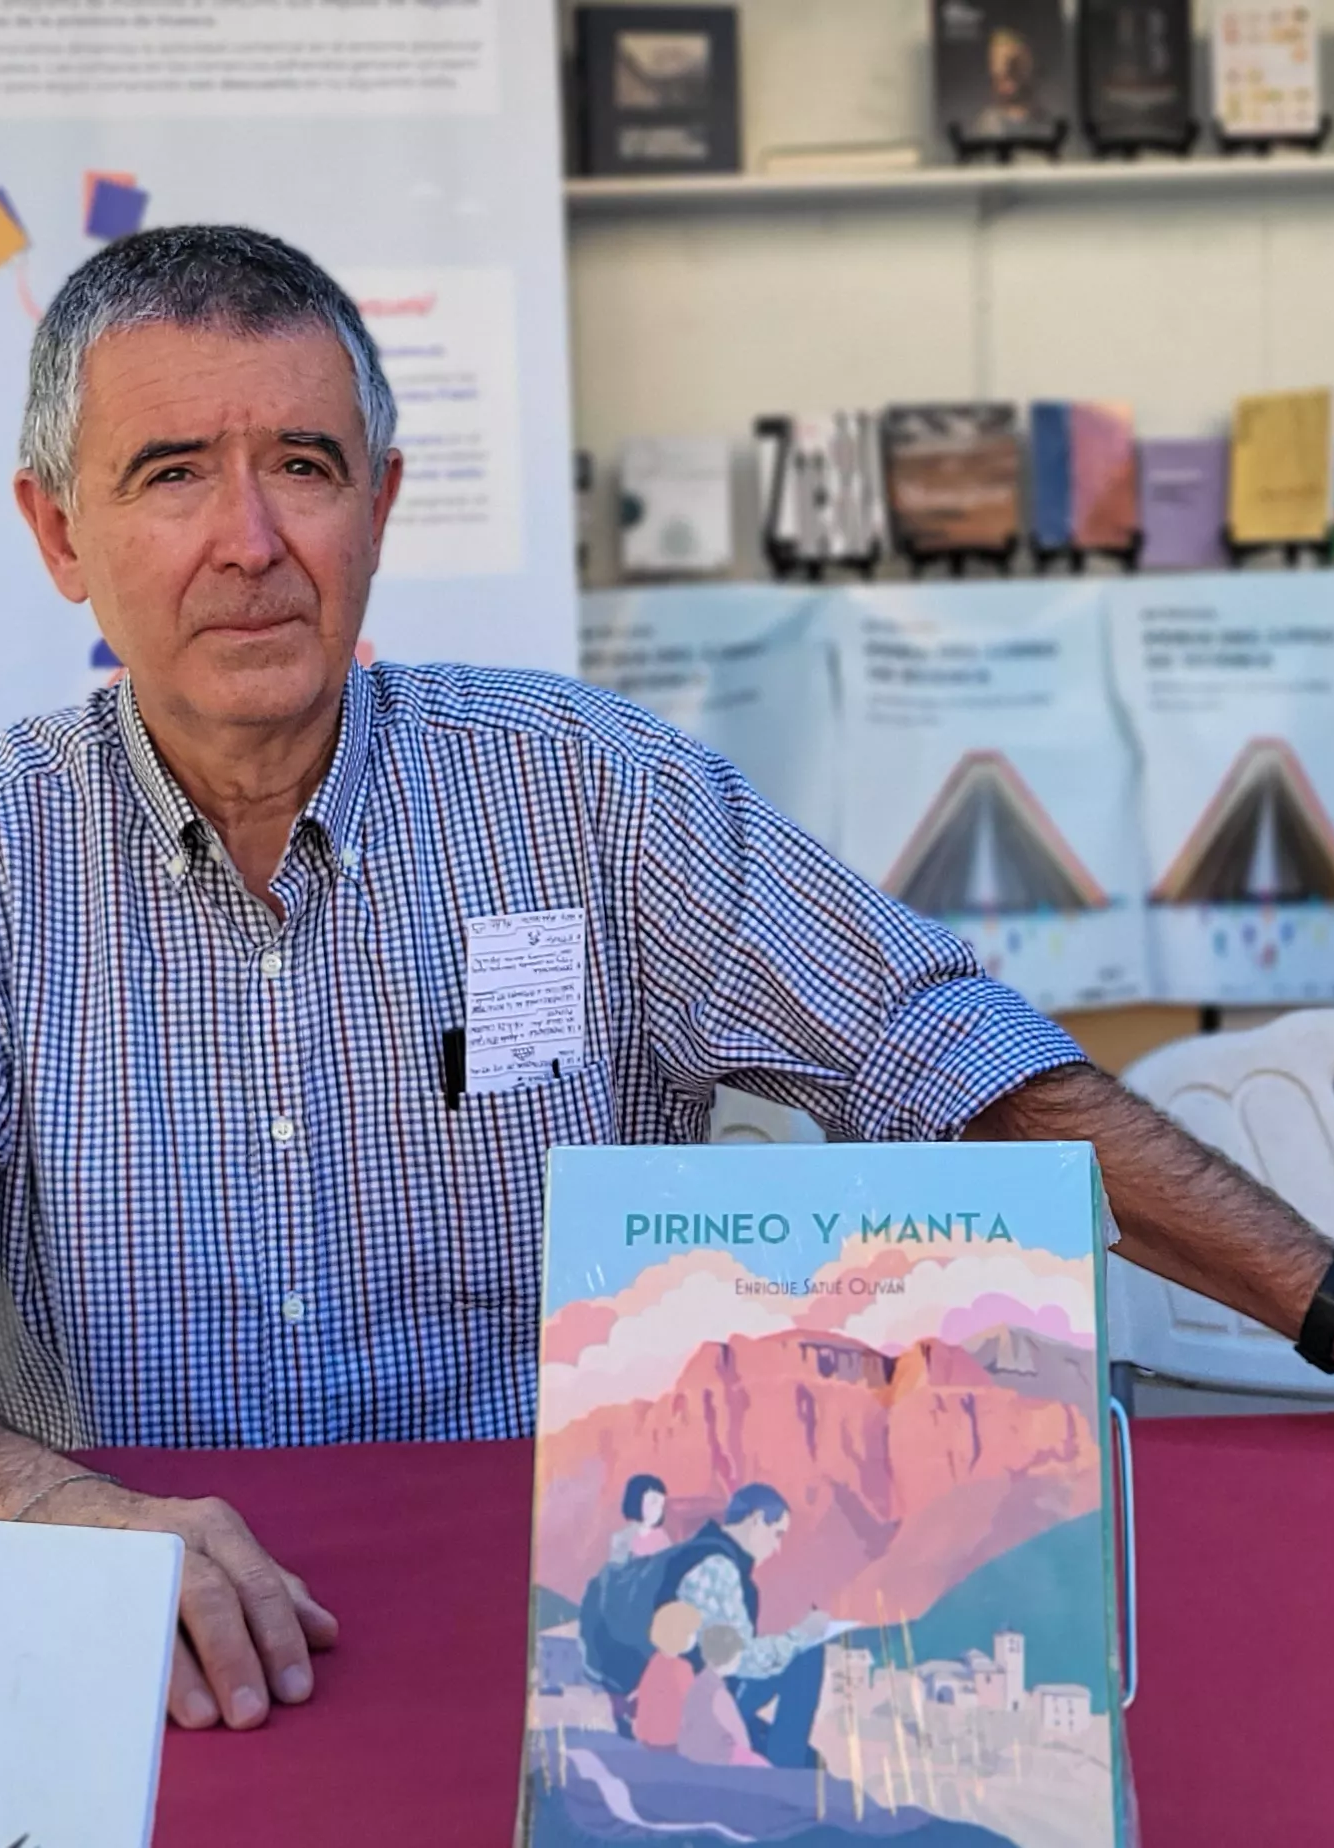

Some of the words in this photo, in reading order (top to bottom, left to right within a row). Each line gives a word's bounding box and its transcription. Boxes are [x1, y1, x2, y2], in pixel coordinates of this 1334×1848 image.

[625, 1212, 790, 1246] PIRINEO
[812, 1212, 840, 1244] Y
[861, 1211, 1014, 1244] MANTA
